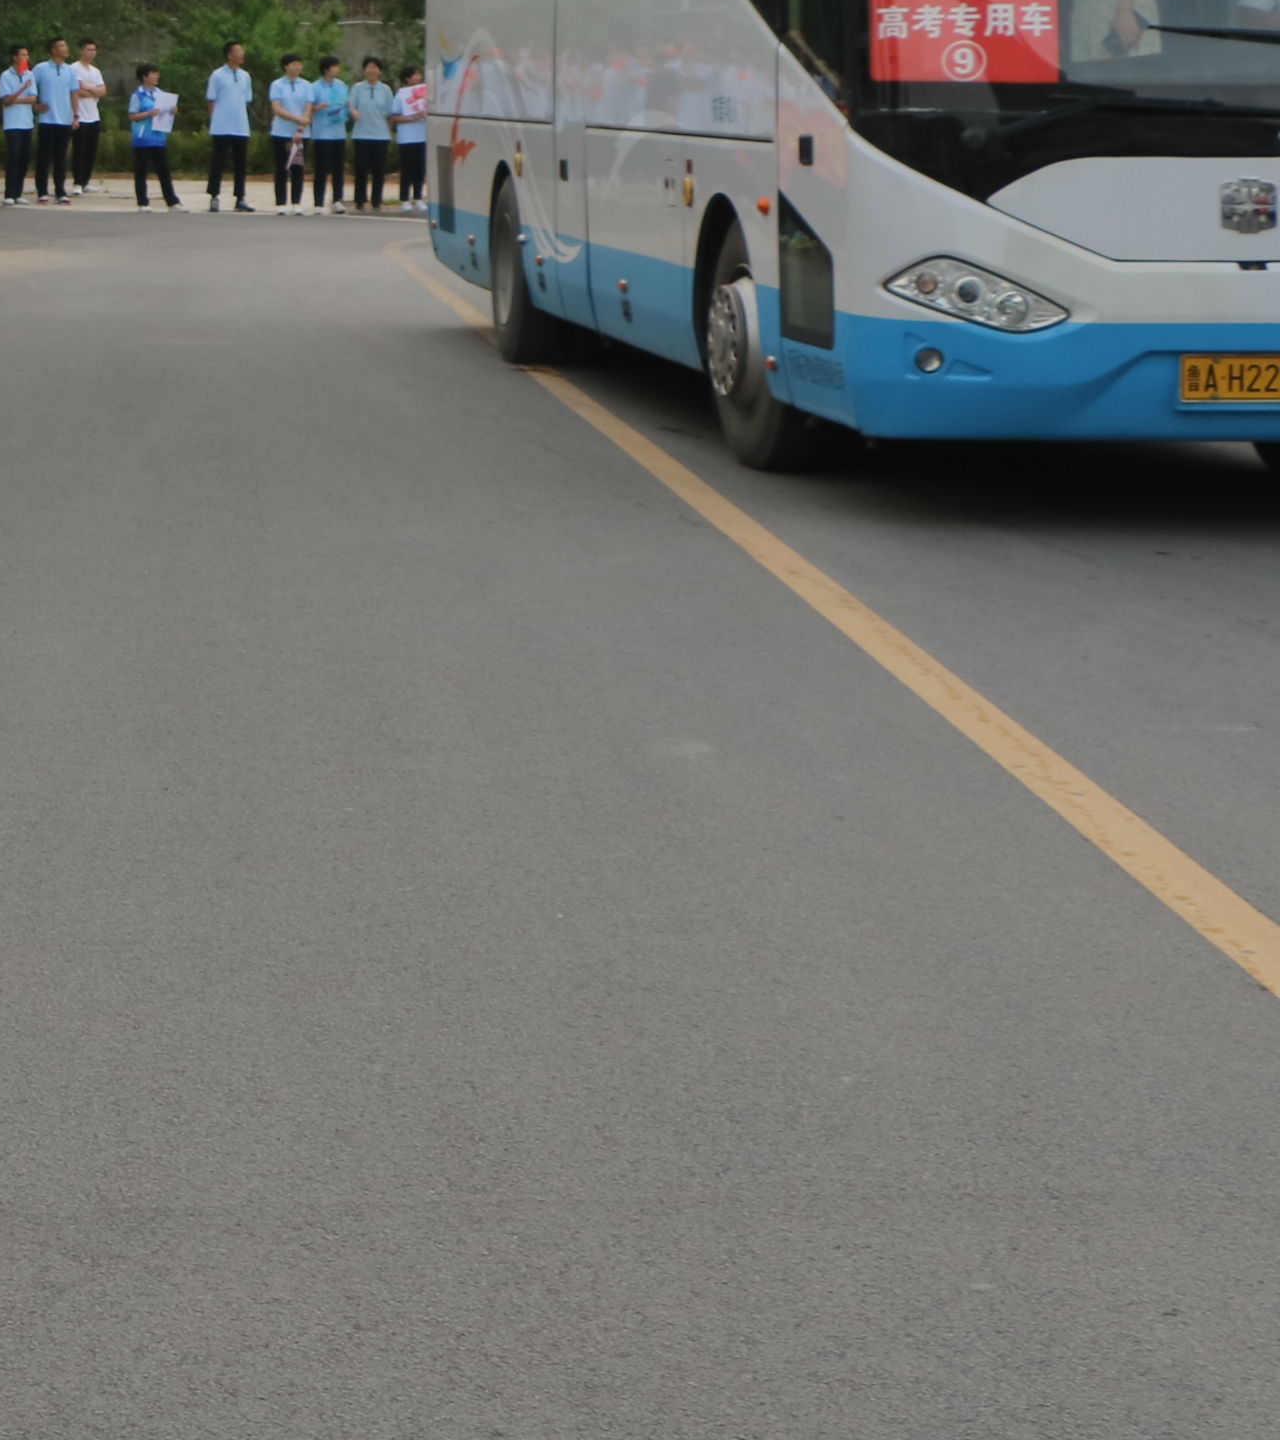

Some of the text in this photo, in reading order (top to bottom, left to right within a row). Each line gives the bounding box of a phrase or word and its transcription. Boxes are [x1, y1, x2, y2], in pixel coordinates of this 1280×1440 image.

[876, 2, 1053, 40] 高考专用车
